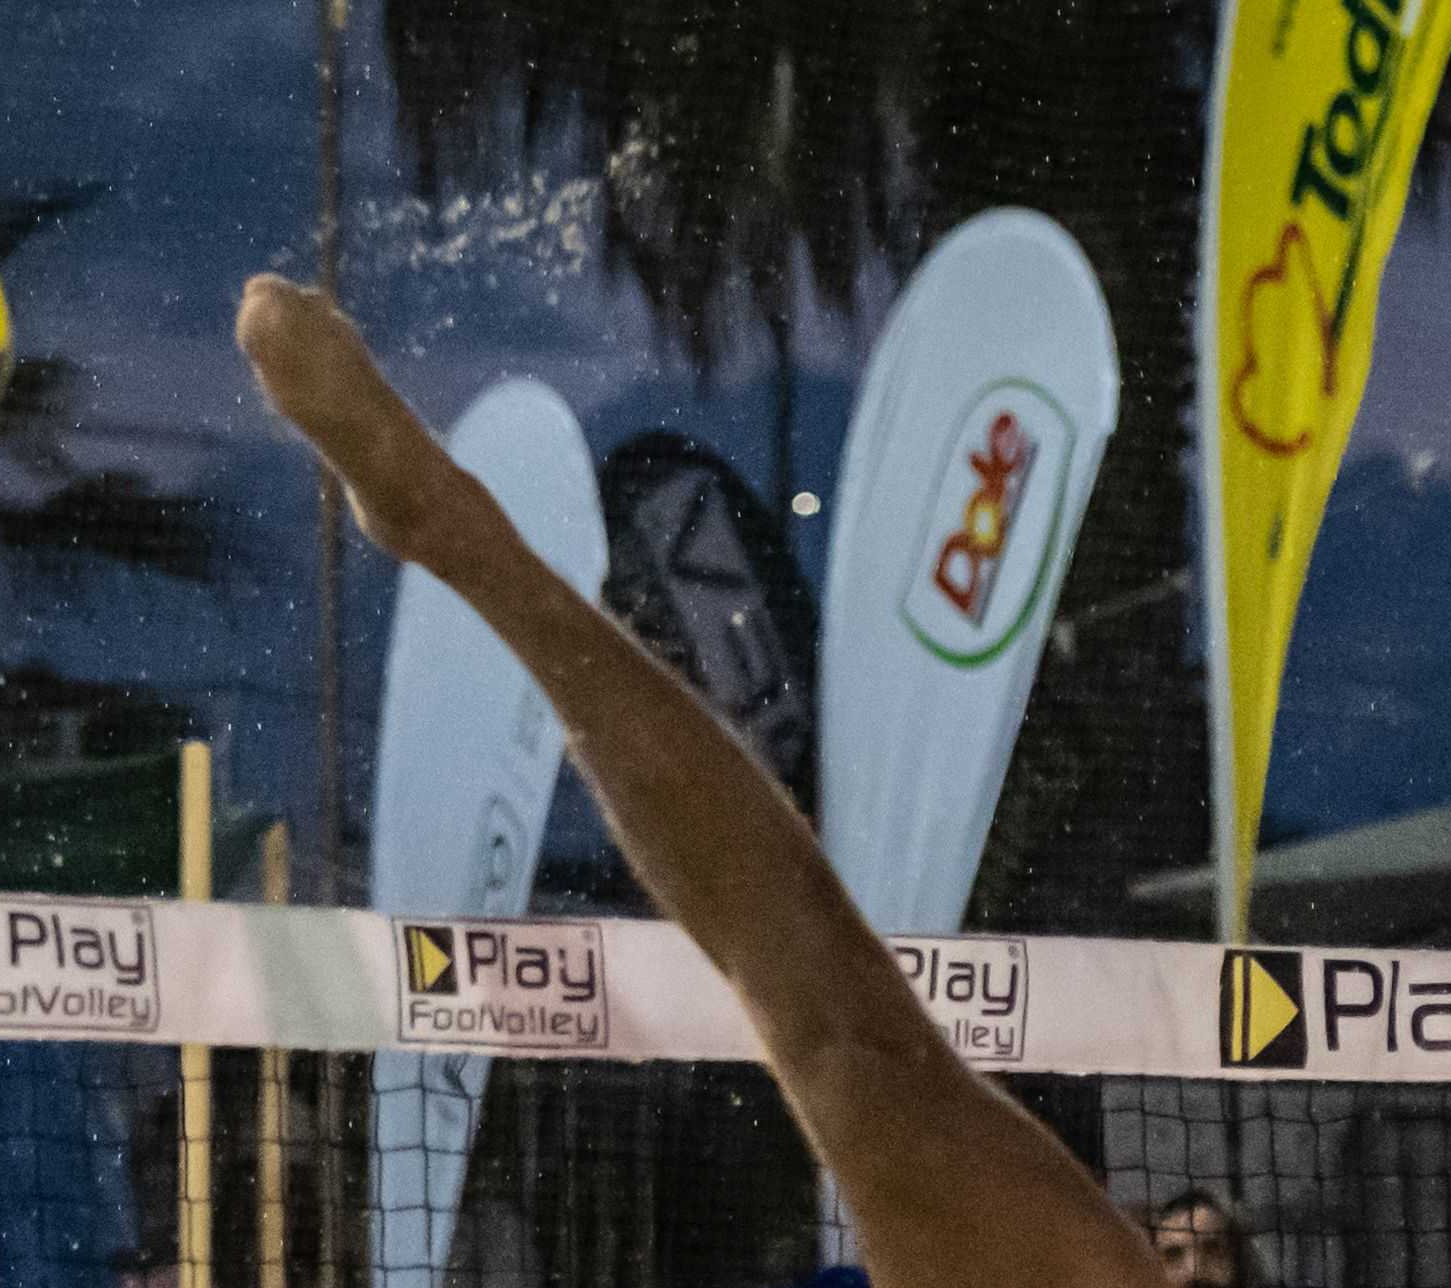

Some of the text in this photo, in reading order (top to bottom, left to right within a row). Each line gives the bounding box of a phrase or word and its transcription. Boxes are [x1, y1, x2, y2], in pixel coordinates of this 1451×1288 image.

[8, 911, 146, 986] Play
[465, 930, 597, 1003] Play
[408, 1000, 599, 1043] FootVolley
